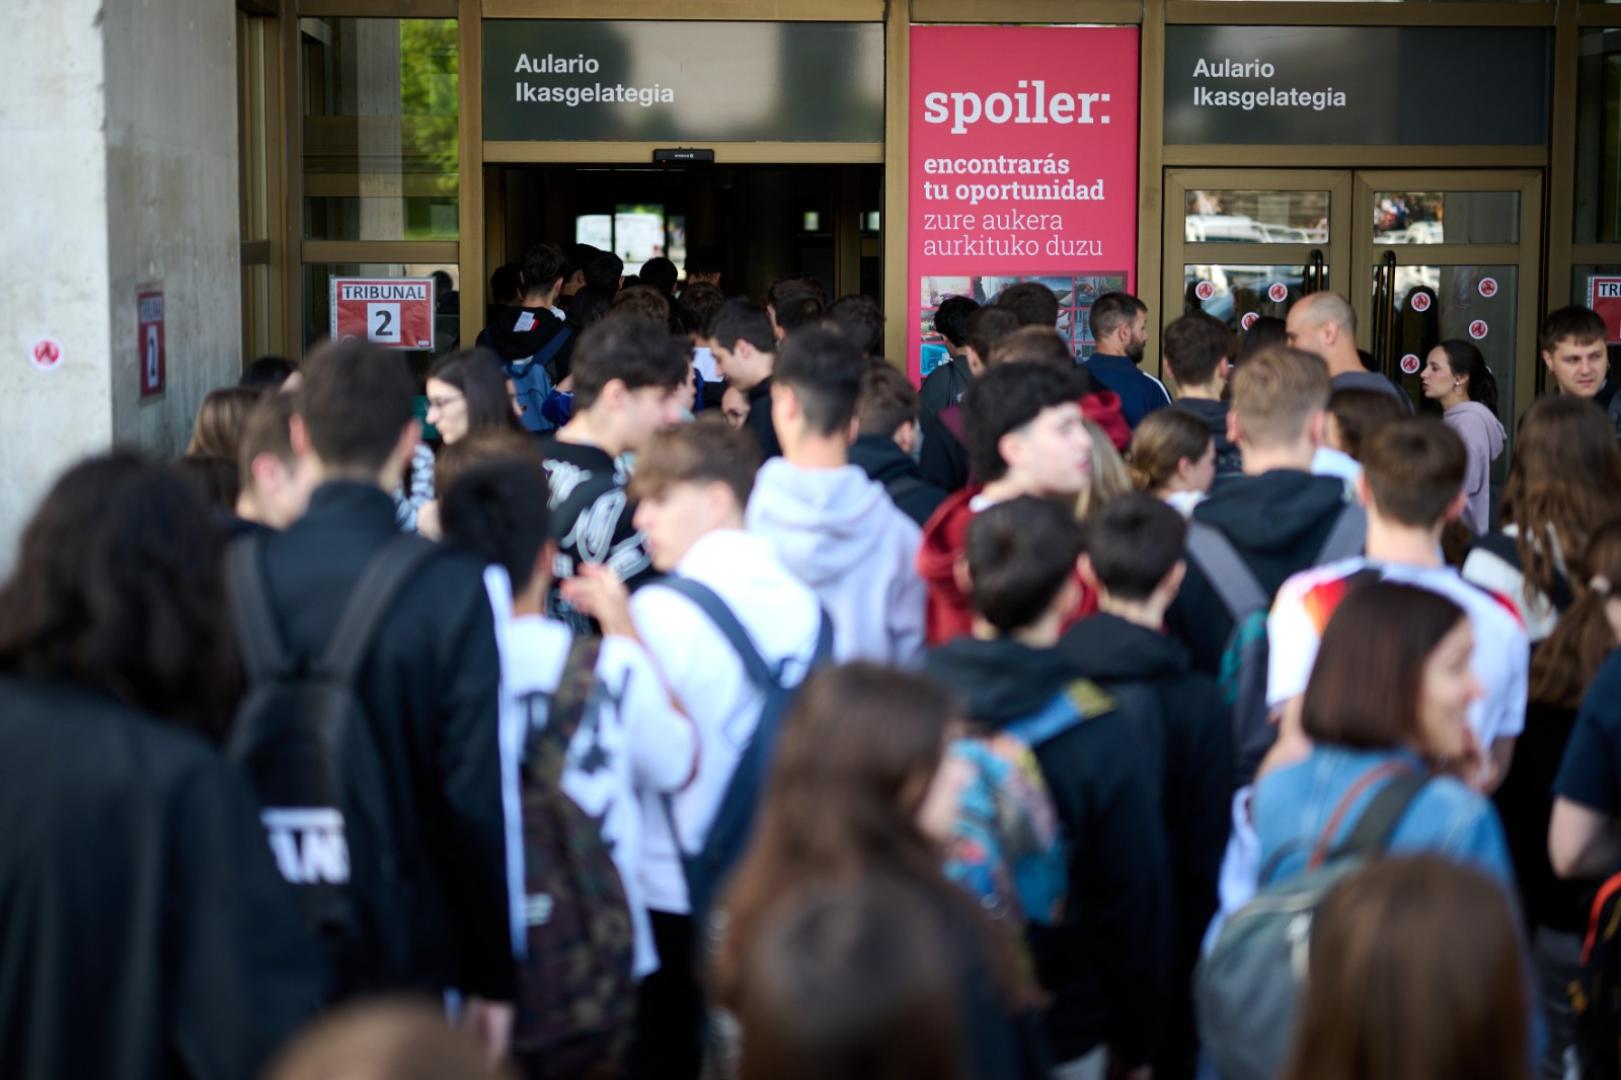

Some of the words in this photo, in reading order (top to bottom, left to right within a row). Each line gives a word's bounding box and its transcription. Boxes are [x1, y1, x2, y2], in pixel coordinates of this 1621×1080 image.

[514, 53, 600, 74] Aulario
[1192, 58, 1275, 78] Aulario
[515, 82, 675, 108] Ikasgelategia
[1192, 86, 1347, 111] Ikasgelategia
[924, 80, 1111, 135] spoiler:
[923, 152, 1071, 175] encontrarás
[923, 181, 950, 201] tu
[955, 178, 1105, 205] oportunidad
[924, 213, 976, 231] zure
[982, 208, 1064, 231] aukera
[923, 234, 1039, 256] aurkituko
[1045, 234, 1103, 256] duzu
[343, 285, 425, 299] TRIBUNAL
[375, 310, 393, 336] 2
